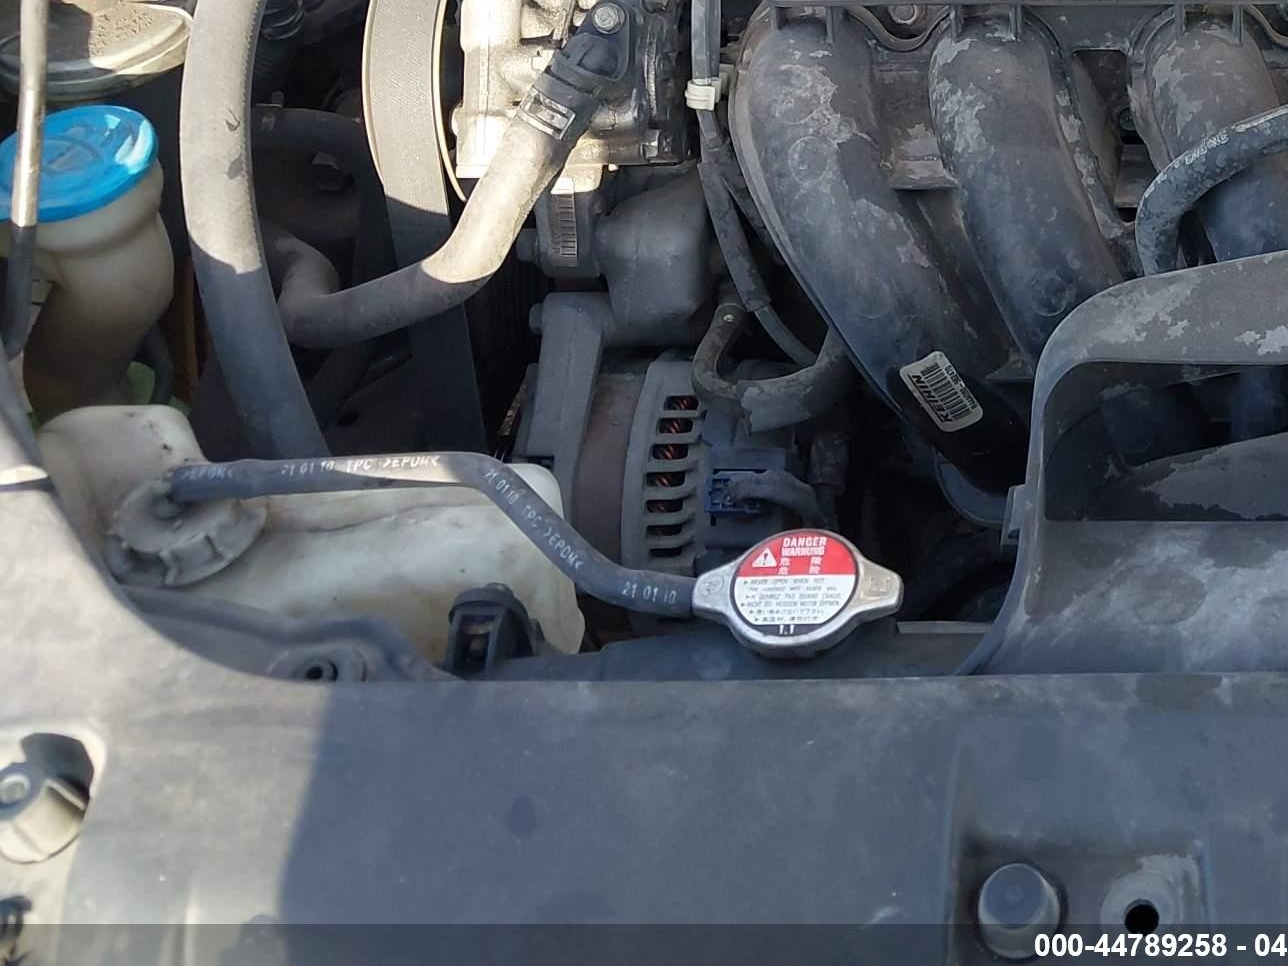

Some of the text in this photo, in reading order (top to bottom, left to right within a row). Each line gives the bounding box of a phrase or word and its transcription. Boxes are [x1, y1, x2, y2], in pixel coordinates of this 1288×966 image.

[911, 374, 953, 423] KEIHIN
[783, 537, 827, 547] DANGER
[781, 547, 825, 556] WARNUNG
